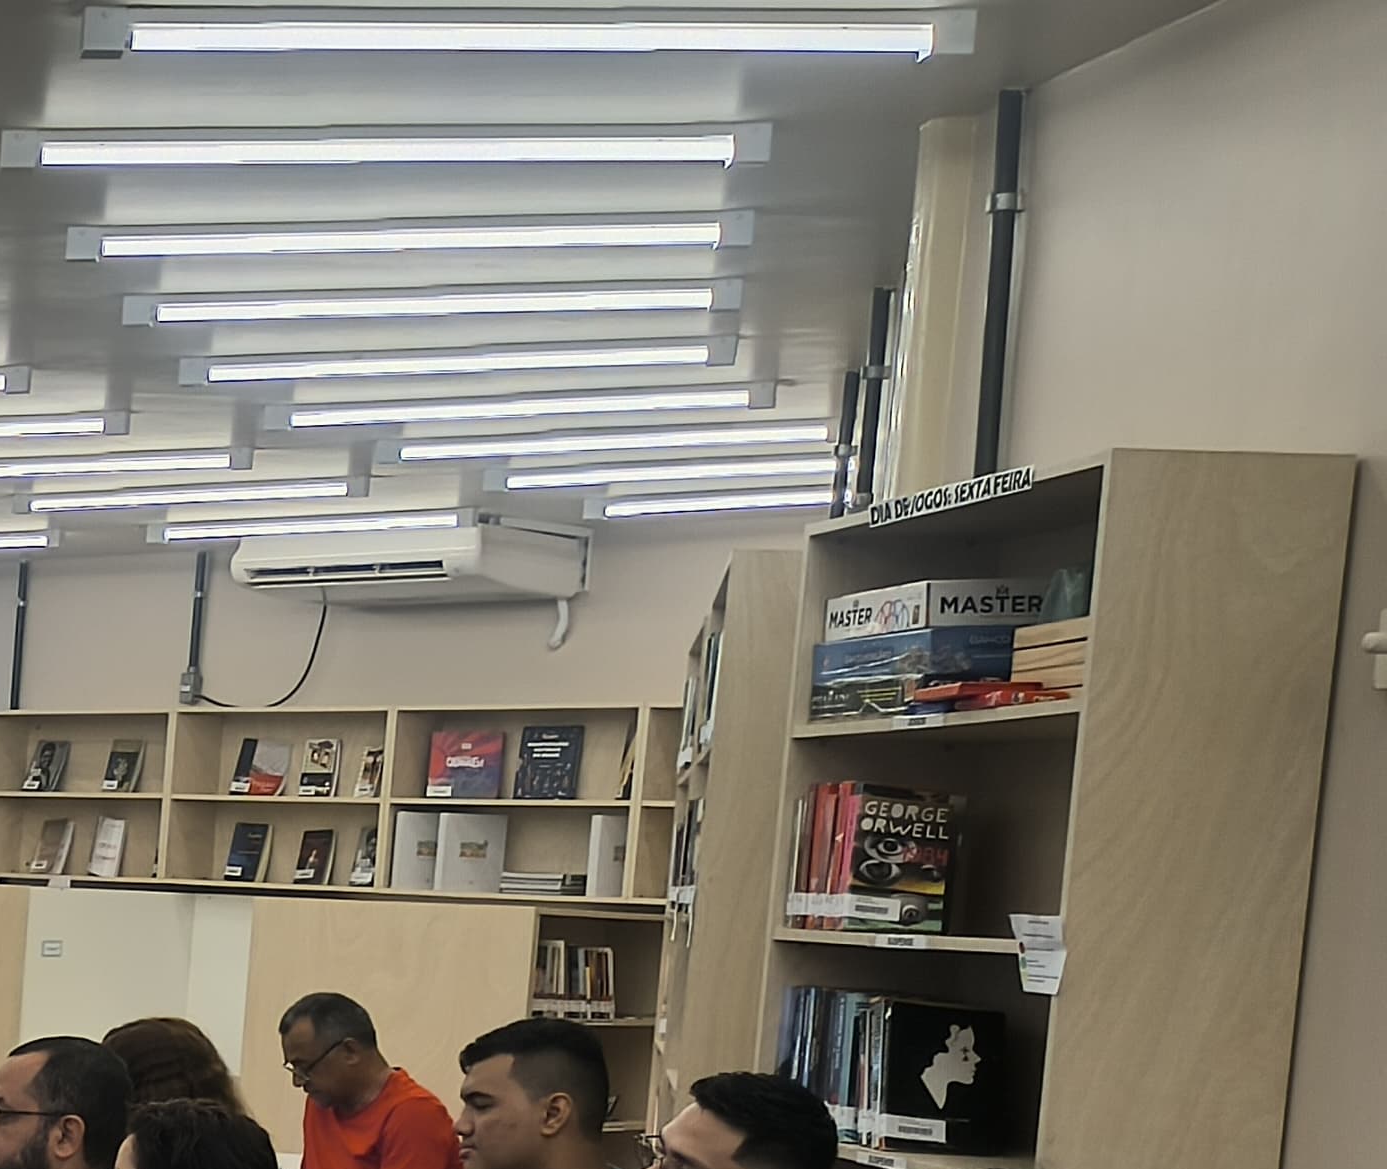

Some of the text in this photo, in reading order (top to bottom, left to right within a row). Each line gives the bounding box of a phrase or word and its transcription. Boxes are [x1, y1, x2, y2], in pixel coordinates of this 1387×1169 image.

[870, 502, 892, 526] DIA
[895, 497, 909, 519] DE
[954, 477, 991, 504] SEXTA
[993, 467, 1031, 496] FEIRA
[940, 594, 1043, 614] MASTER
[829, 607, 872, 629] MASTER
[865, 801, 949, 823] GEORGE
[860, 817, 949, 840] ORWELL
